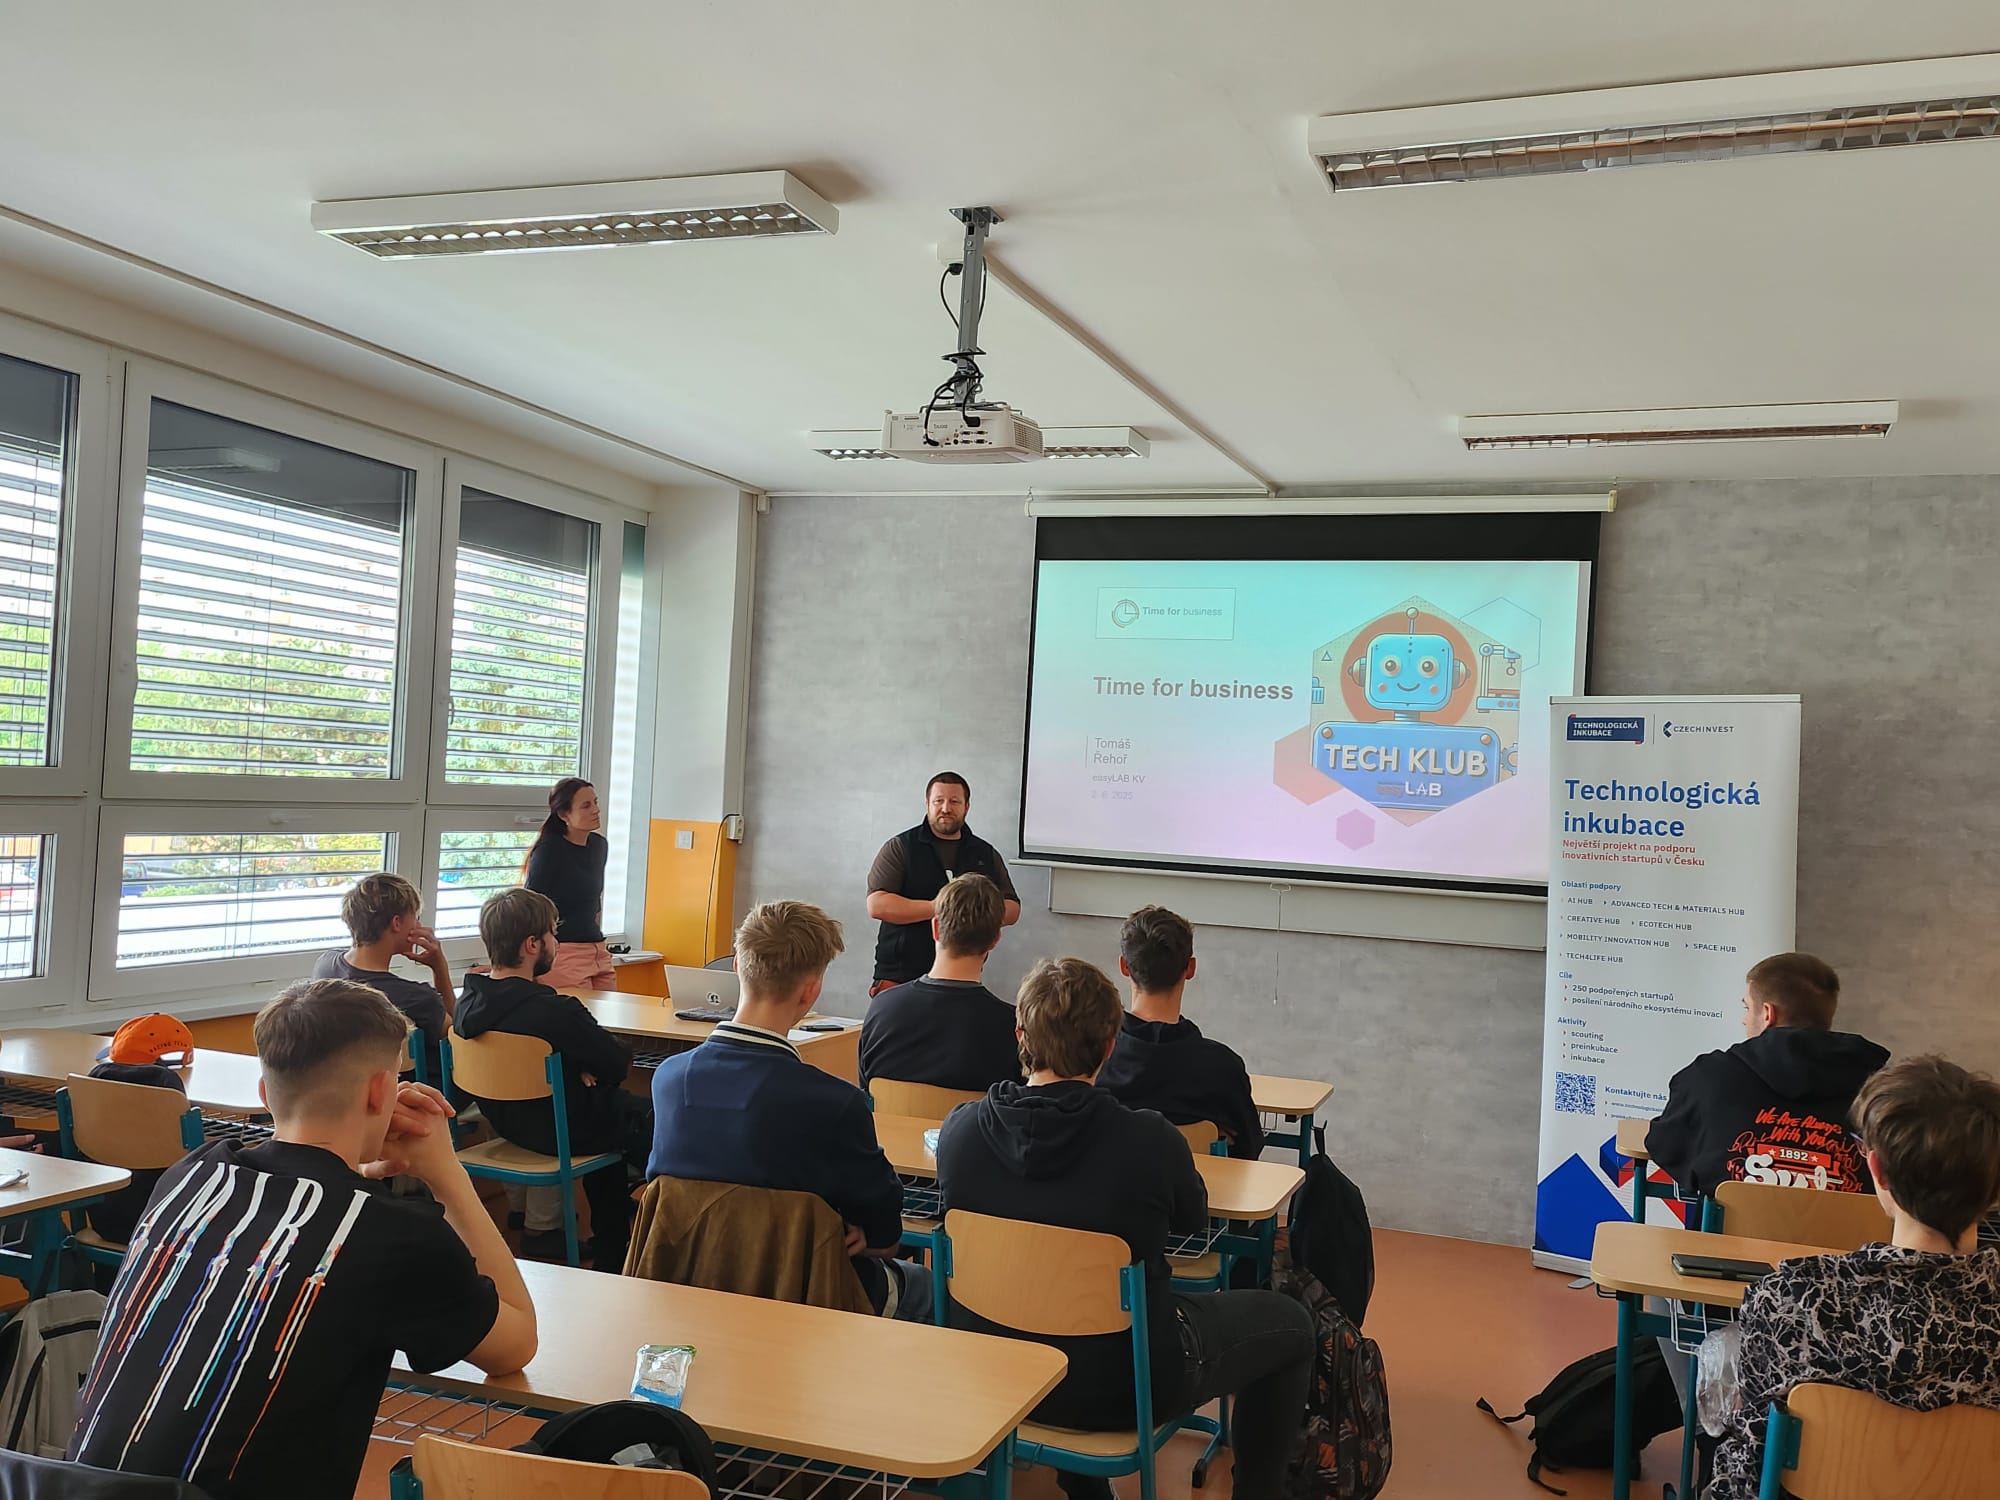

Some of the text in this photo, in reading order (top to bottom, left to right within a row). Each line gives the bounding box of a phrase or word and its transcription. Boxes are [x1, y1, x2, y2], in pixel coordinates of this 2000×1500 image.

[1142, 606, 1223, 617] Time for business
[1093, 676, 1294, 701] Time for business
[1573, 721, 1639, 729] TECHNOLOGICKÁ
[1673, 725, 1735, 734] CZECHINVEST
[1572, 729, 1613, 737] INKUBACE
[1095, 737, 1132, 750] Tomáš
[1093, 750, 1129, 765] Řehoř
[1324, 743, 1488, 777] TECH KLUB
[1132, 774, 1146, 783] KV
[1564, 778, 1761, 810] Technologická
[1563, 810, 1685, 837] inkubace
[1562, 839, 1696, 854] Největší projekt na podporu
[1562, 851, 1619, 862] inovativních
[1622, 853, 1663, 865] startupů
[1673, 854, 1705, 866] Česku
[1561, 880, 1621, 892] Oblasti podpory
[1611, 900, 1651, 909] ADVANCED
[1682, 904, 1727, 914] MATERIALS
[1728, 907, 1745, 915] HUB
[1567, 915, 1621, 925] CREATIVE HUB
[1639, 920, 1692, 931] ECOTECH HUB
[1567, 933, 1670, 948] MOBILITY INNOVATION HUB
[1693, 943, 1737, 953] SPACE HUB
[1566, 952, 1624, 963] TECH4LIFE HUB
[1559, 971, 1573, 979] Cíle
[1572, 984, 1674, 1002] 250 podpořených startupů
[1572, 996, 1723, 1018] posílení národního ekosystému inovací
[1557, 1017, 1587, 1027] Aktivity
[1571, 1030, 1604, 1041] scouting
[1570, 1042, 1619, 1054] preinkubace
[1570, 1053, 1605, 1064] inkubace
[1605, 1085, 1667, 1101] Kontaktujte nás
[1770, 1126, 1801, 1143] With
[1780, 1148, 1809, 1161] 1892
